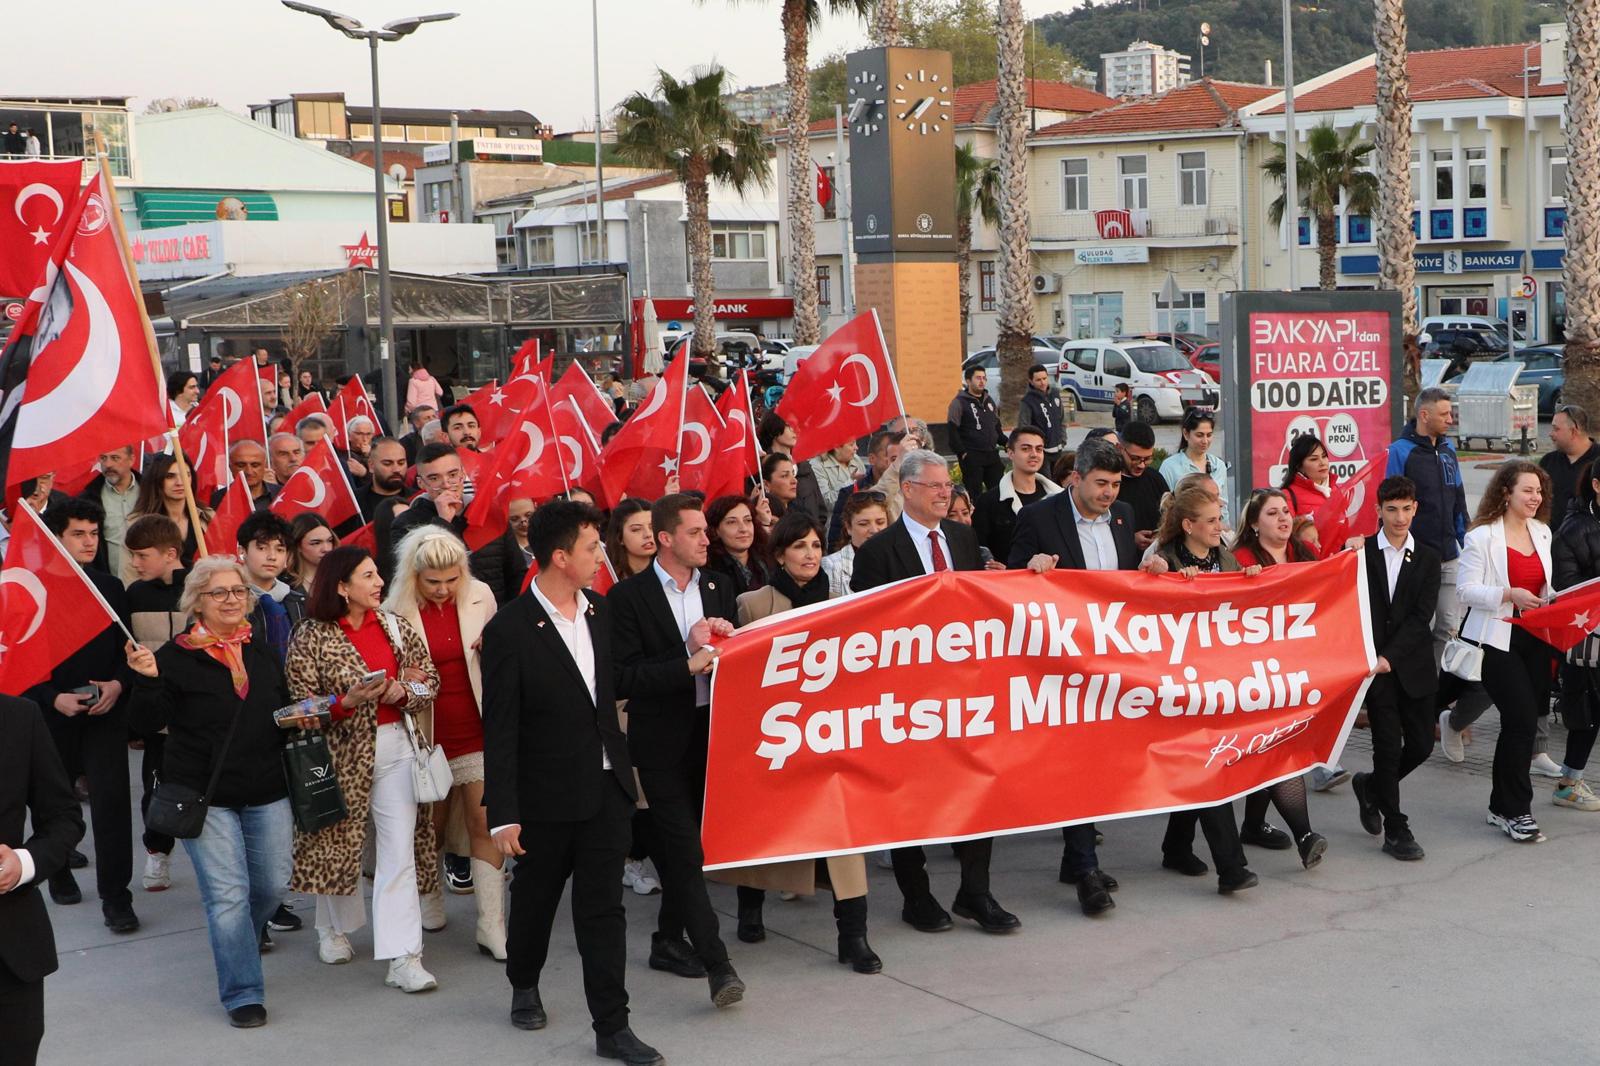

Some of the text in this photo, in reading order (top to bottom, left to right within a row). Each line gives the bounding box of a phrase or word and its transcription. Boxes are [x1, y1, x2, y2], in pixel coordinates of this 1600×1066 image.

[147, 234, 209, 263] YILDIZ CAFE
[1464, 256, 1515, 266] BANKASI
[686, 304, 749, 314] ABANK
[1255, 346, 1380, 375] FUARA ÖZEL
[1257, 382, 1301, 409] 100
[1328, 434, 1356, 444] PROJE
[761, 602, 1317, 693] Egemenlik Kayıtsız
[755, 658, 1323, 770] Şartsız Milletindir.
